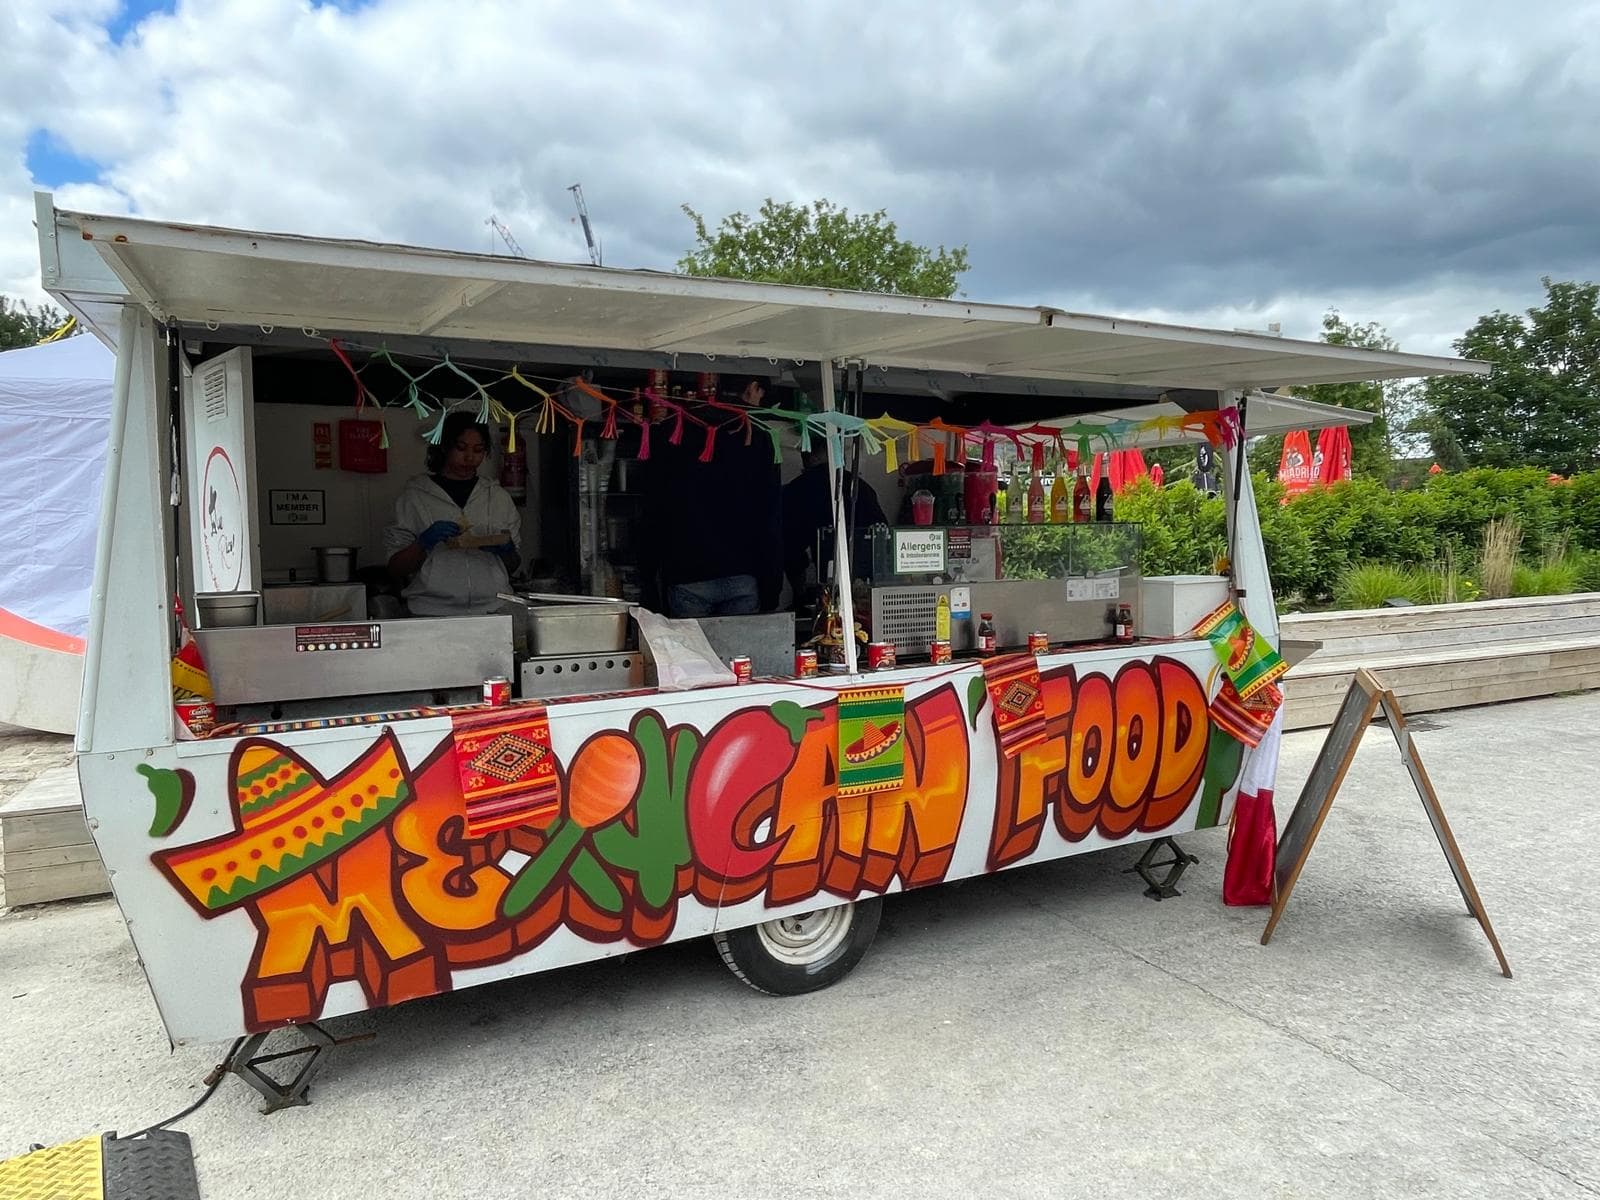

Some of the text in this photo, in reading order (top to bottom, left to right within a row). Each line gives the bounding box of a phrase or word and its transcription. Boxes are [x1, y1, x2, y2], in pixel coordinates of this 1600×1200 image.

[276, 503, 320, 511] MEMBER
[900, 542, 942, 552] Allergens
[240, 655, 1209, 1034] MEXICAN FOOD
